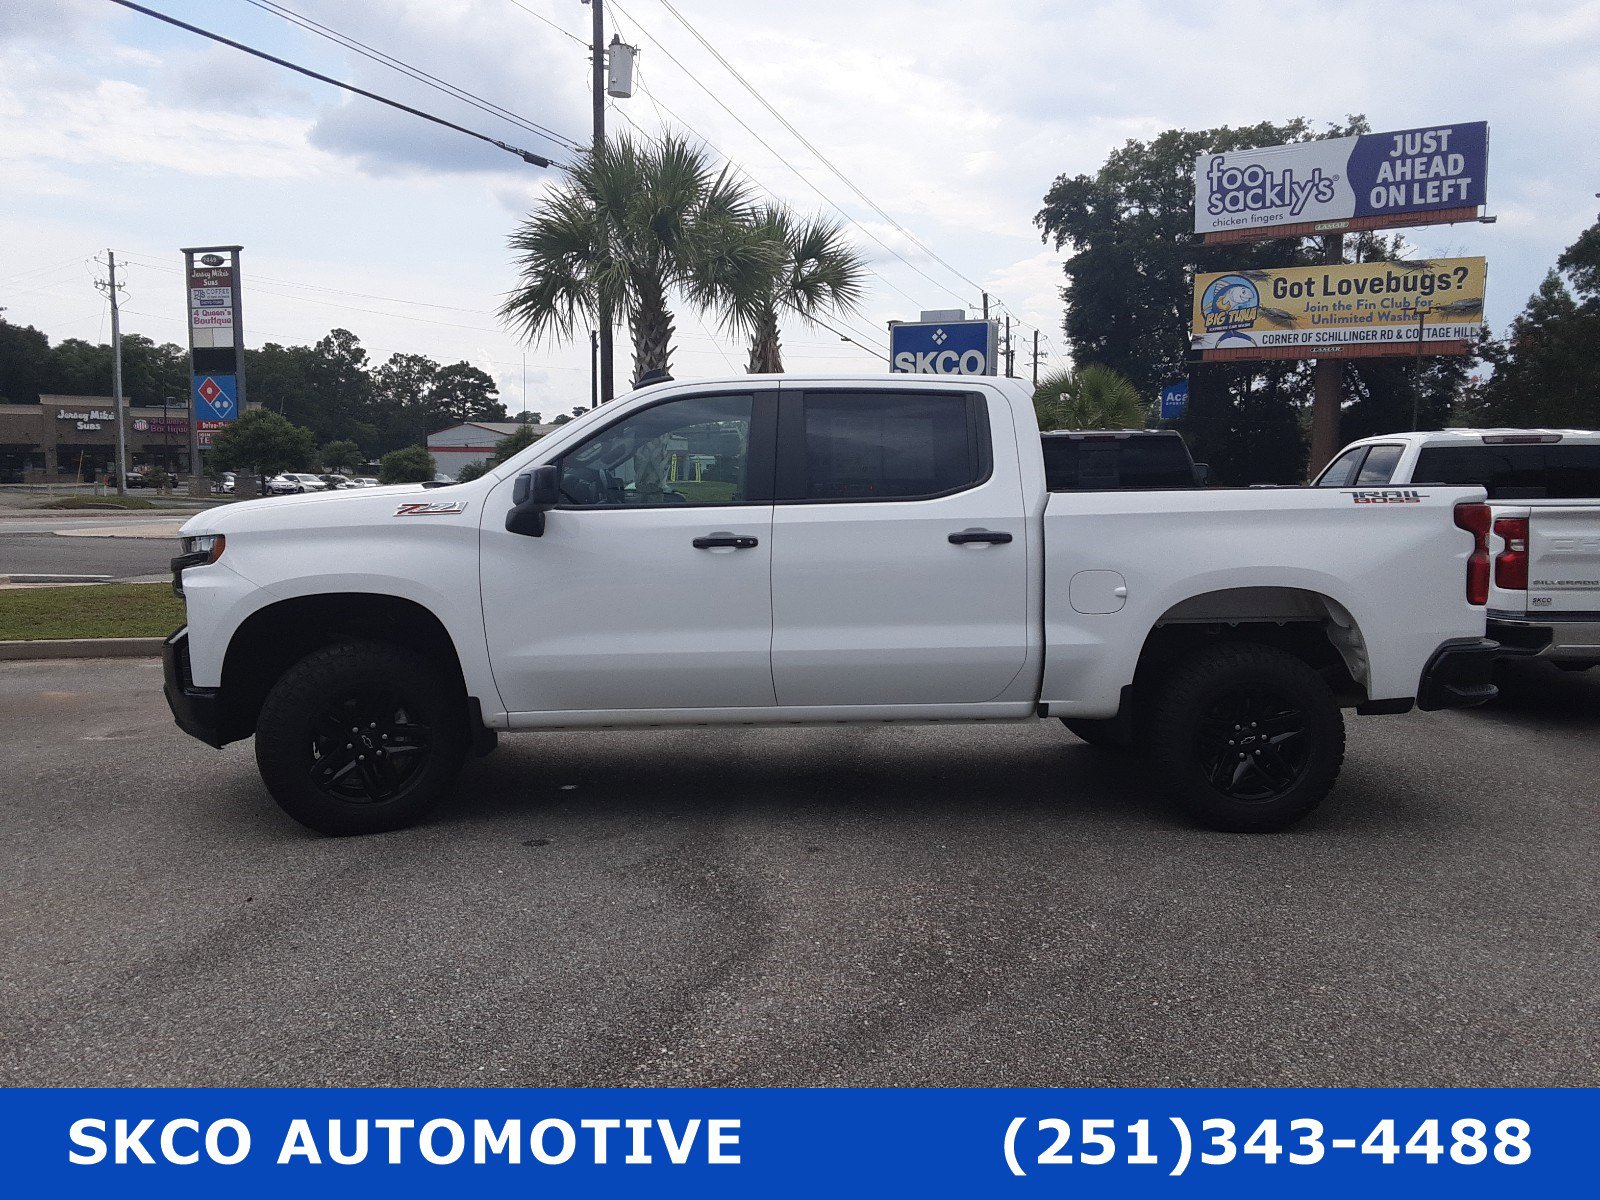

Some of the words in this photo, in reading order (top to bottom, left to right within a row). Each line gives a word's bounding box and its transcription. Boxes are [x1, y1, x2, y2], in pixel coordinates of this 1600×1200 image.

[1389, 129, 1452, 157] JUST
[1207, 156, 1265, 192] foo
[1376, 153, 1465, 183] AHEAD
[1208, 168, 1334, 216] sackly's
[1370, 184, 1406, 209] ON
[1413, 177, 1472, 205] LEFT
[1212, 216, 1248, 227] chicken
[1250, 213, 1284, 225] fingers
[191, 269, 211, 279] Jersey
[1273, 277, 1316, 299] Got
[1322, 266, 1469, 296] Lovebugs?
[1303, 301, 1329, 312] Join
[1332, 300, 1352, 311] the
[1356, 299, 1377, 310] Fin
[1380, 297, 1411, 309] Club
[1415, 296, 1434, 308] for
[193, 316, 231, 325] Boutique
[202, 309, 231, 317] Queen's
[1205, 312, 1226, 326] BIG
[1228, 308, 1257, 324] TUNA
[1311, 312, 1373, 325] Unlimited
[1378, 308, 1423, 322] Washe
[1262, 333, 1299, 345] CORNER
[1301, 332, 1314, 343] OF
[1315, 329, 1378, 342] SCHILLINGER
[1380, 330, 1394, 340] RD
[1395, 328, 1403, 339] &
[1405, 327, 1452, 339] COTAGE
[1453, 326, 1477, 338] HILL
[894, 349, 986, 375] SKCO
[57, 409, 89, 421] Jersey
[77, 421, 101, 430] Subs
[1340, 490, 1430, 498] TRAIL
[393, 501, 468, 517] Z71
